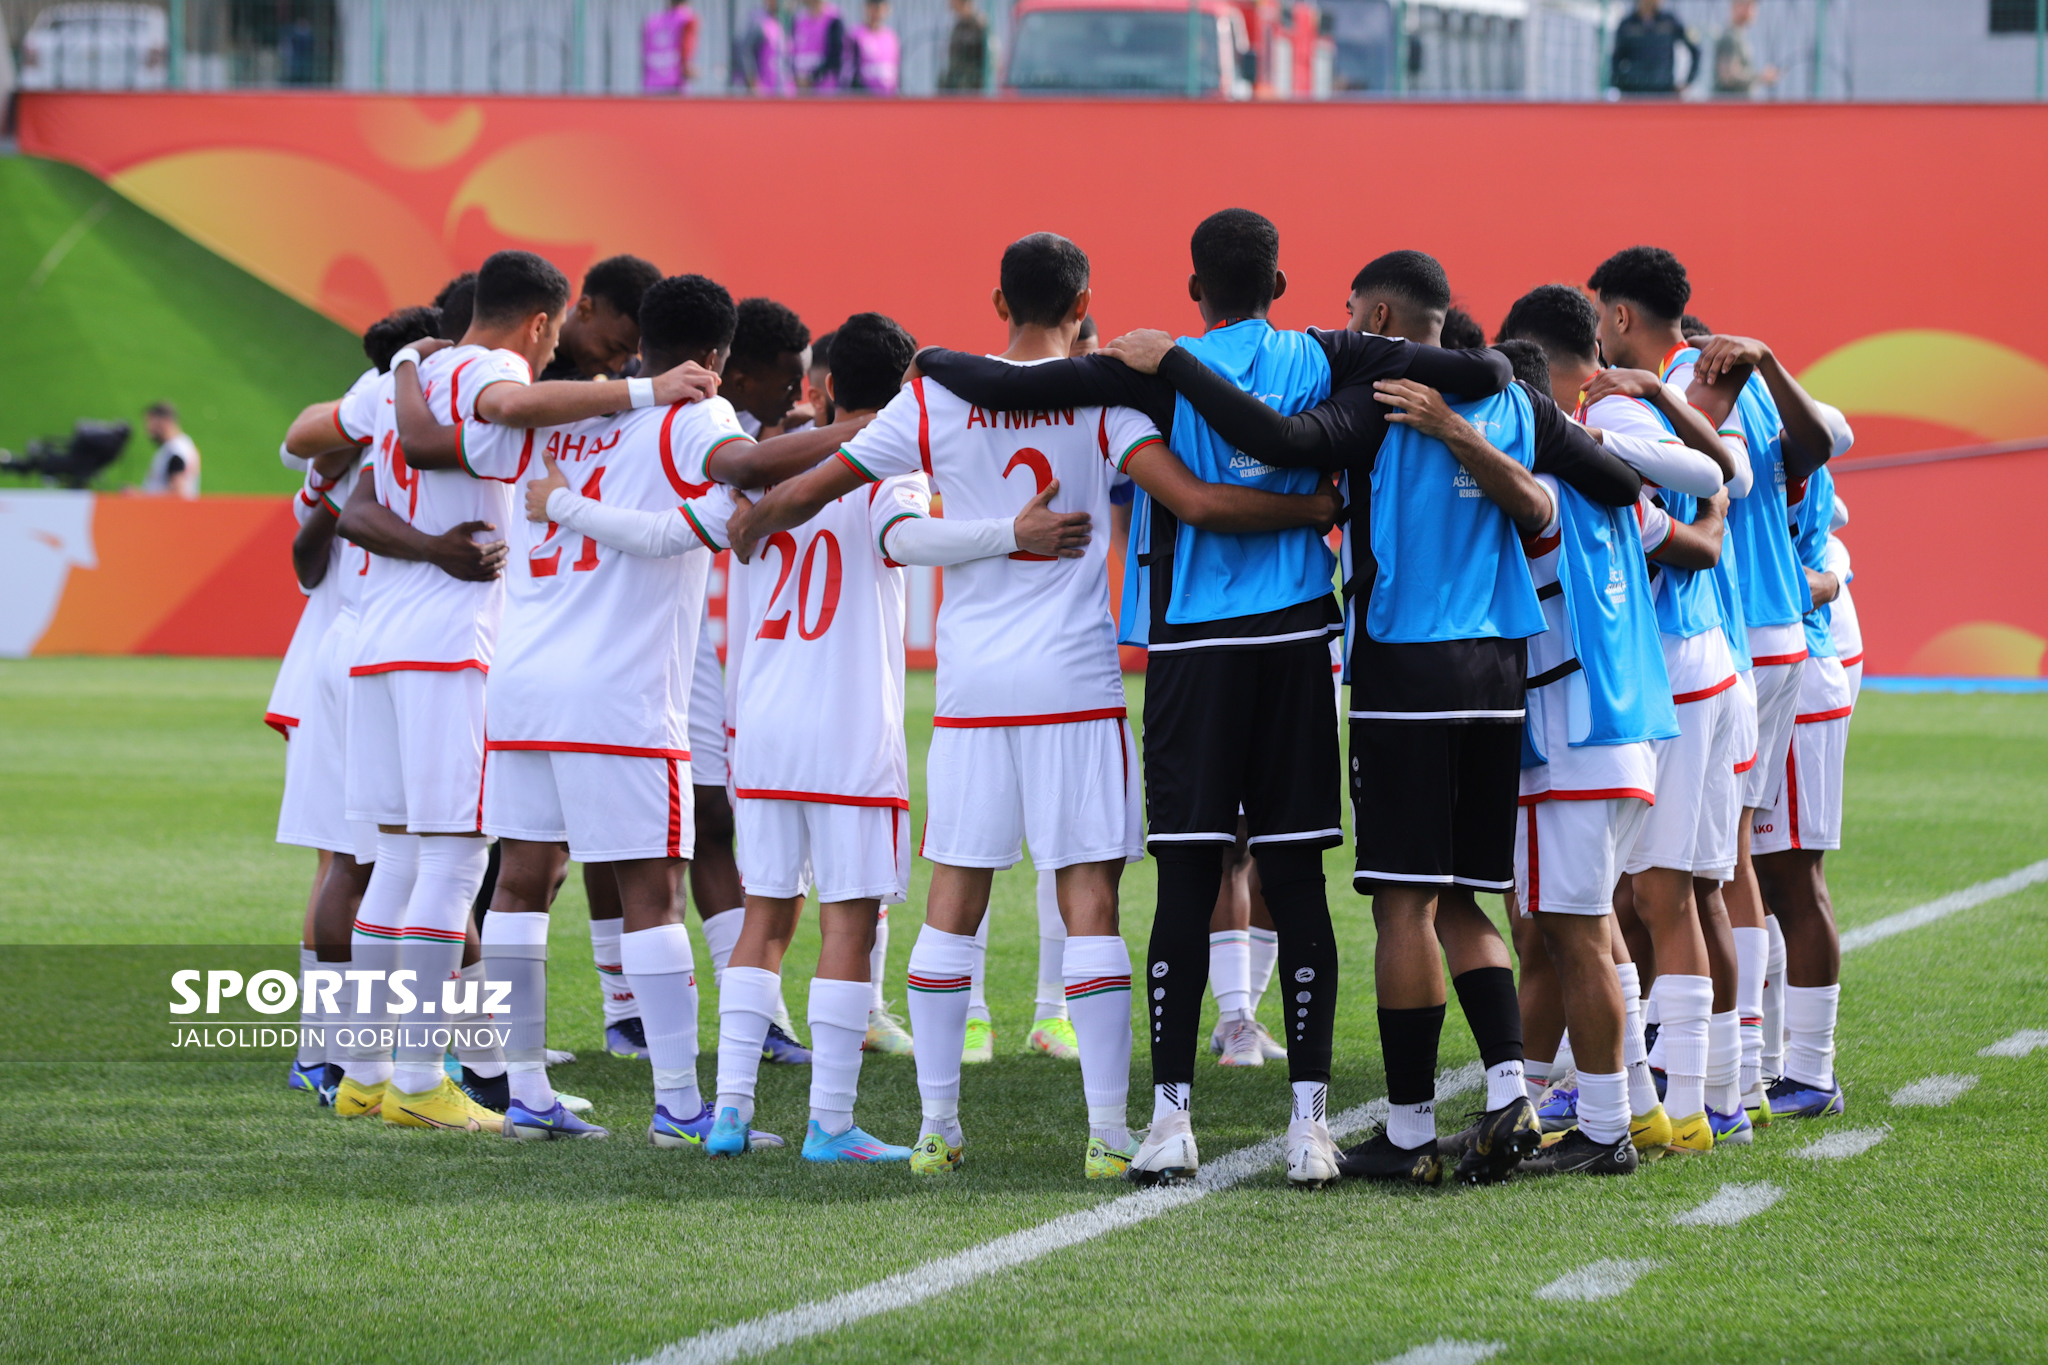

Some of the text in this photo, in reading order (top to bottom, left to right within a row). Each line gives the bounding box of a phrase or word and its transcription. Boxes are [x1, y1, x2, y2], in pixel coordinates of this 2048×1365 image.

[967, 405, 1075, 430] AYMAN
[1229, 455, 1261, 469] ASIA
[1453, 476, 1478, 487] ASIA
[1002, 447, 1059, 561] 2
[755, 529, 842, 641] 20
[1753, 824, 1774, 835] AKO
[1499, 1069, 1524, 1078] JAK
